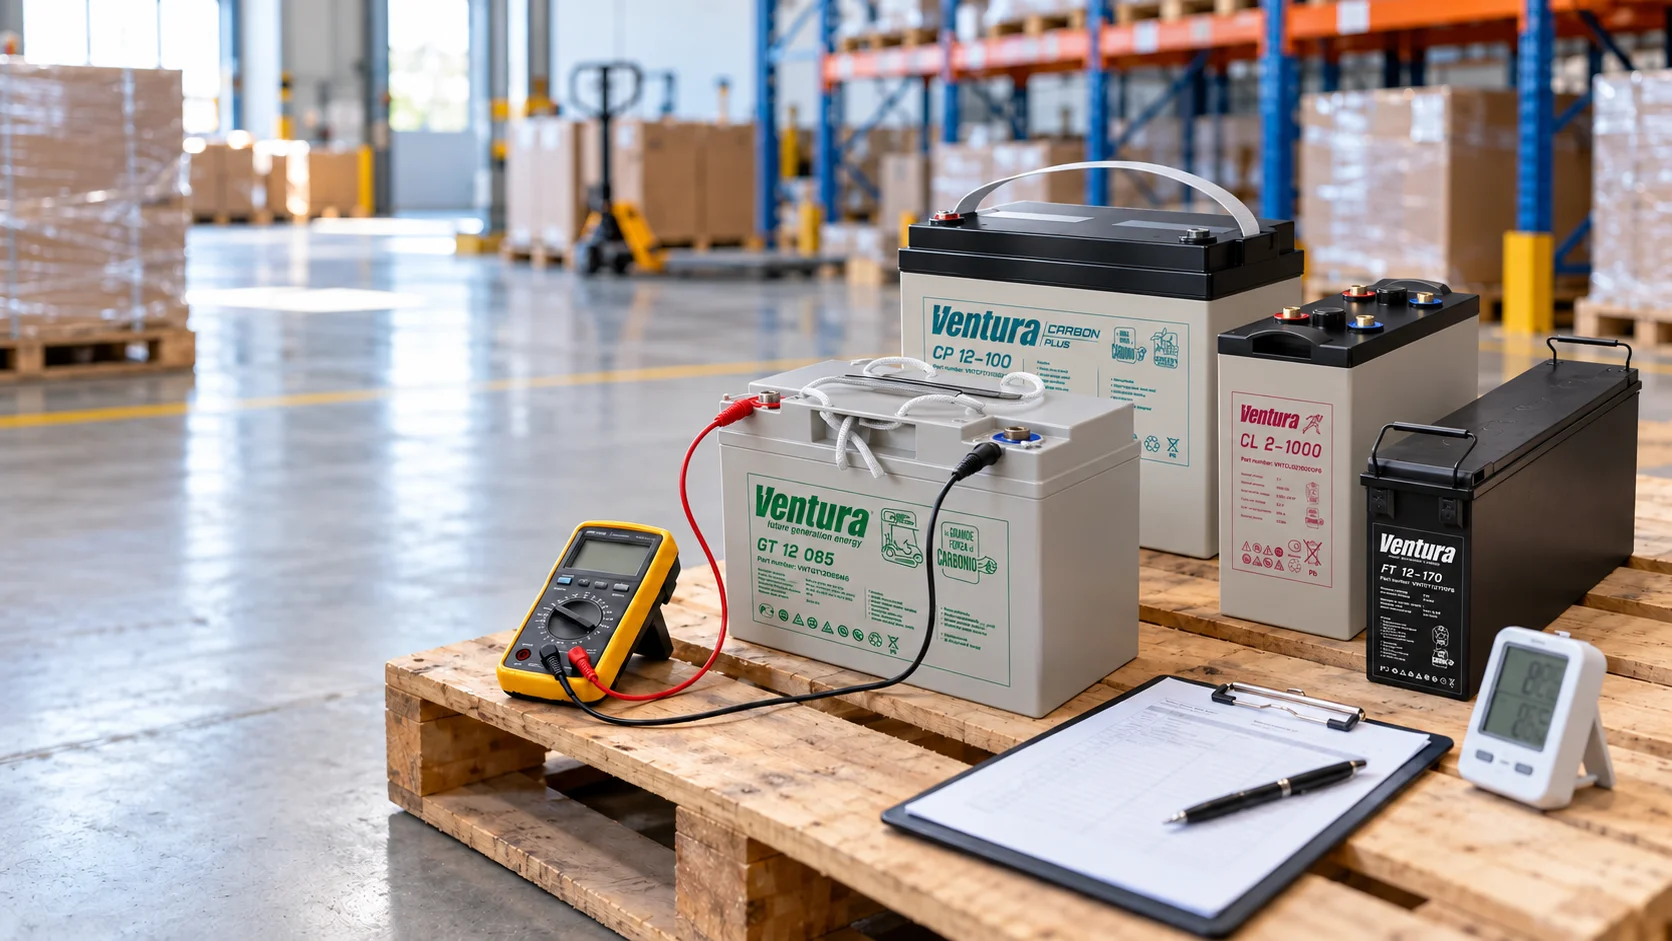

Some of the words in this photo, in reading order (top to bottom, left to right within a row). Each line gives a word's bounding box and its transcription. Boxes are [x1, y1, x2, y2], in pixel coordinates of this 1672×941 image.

[933, 305, 1041, 346] Ventura
[1048, 324, 1101, 340] CARBON
[1044, 338, 1071, 349] PLUS
[933, 345, 954, 360] CP
[959, 348, 1013, 369] 12-100
[1240, 404, 1300, 430] Ventura
[1241, 432, 1258, 449] CL
[1264, 436, 1322, 458] 2-1000
[756, 484, 869, 538] Ventura
[791, 527, 833, 541] generation
[834, 536, 862, 549] energy
[1380, 533, 1457, 564] Ventura
[757, 538, 778, 554] GT
[783, 544, 799, 559] 12
[804, 548, 835, 566] 085
[937, 548, 977, 572] CARBONIO
[1381, 564, 1397, 575] FT
[1402, 567, 1443, 583] 12-170
